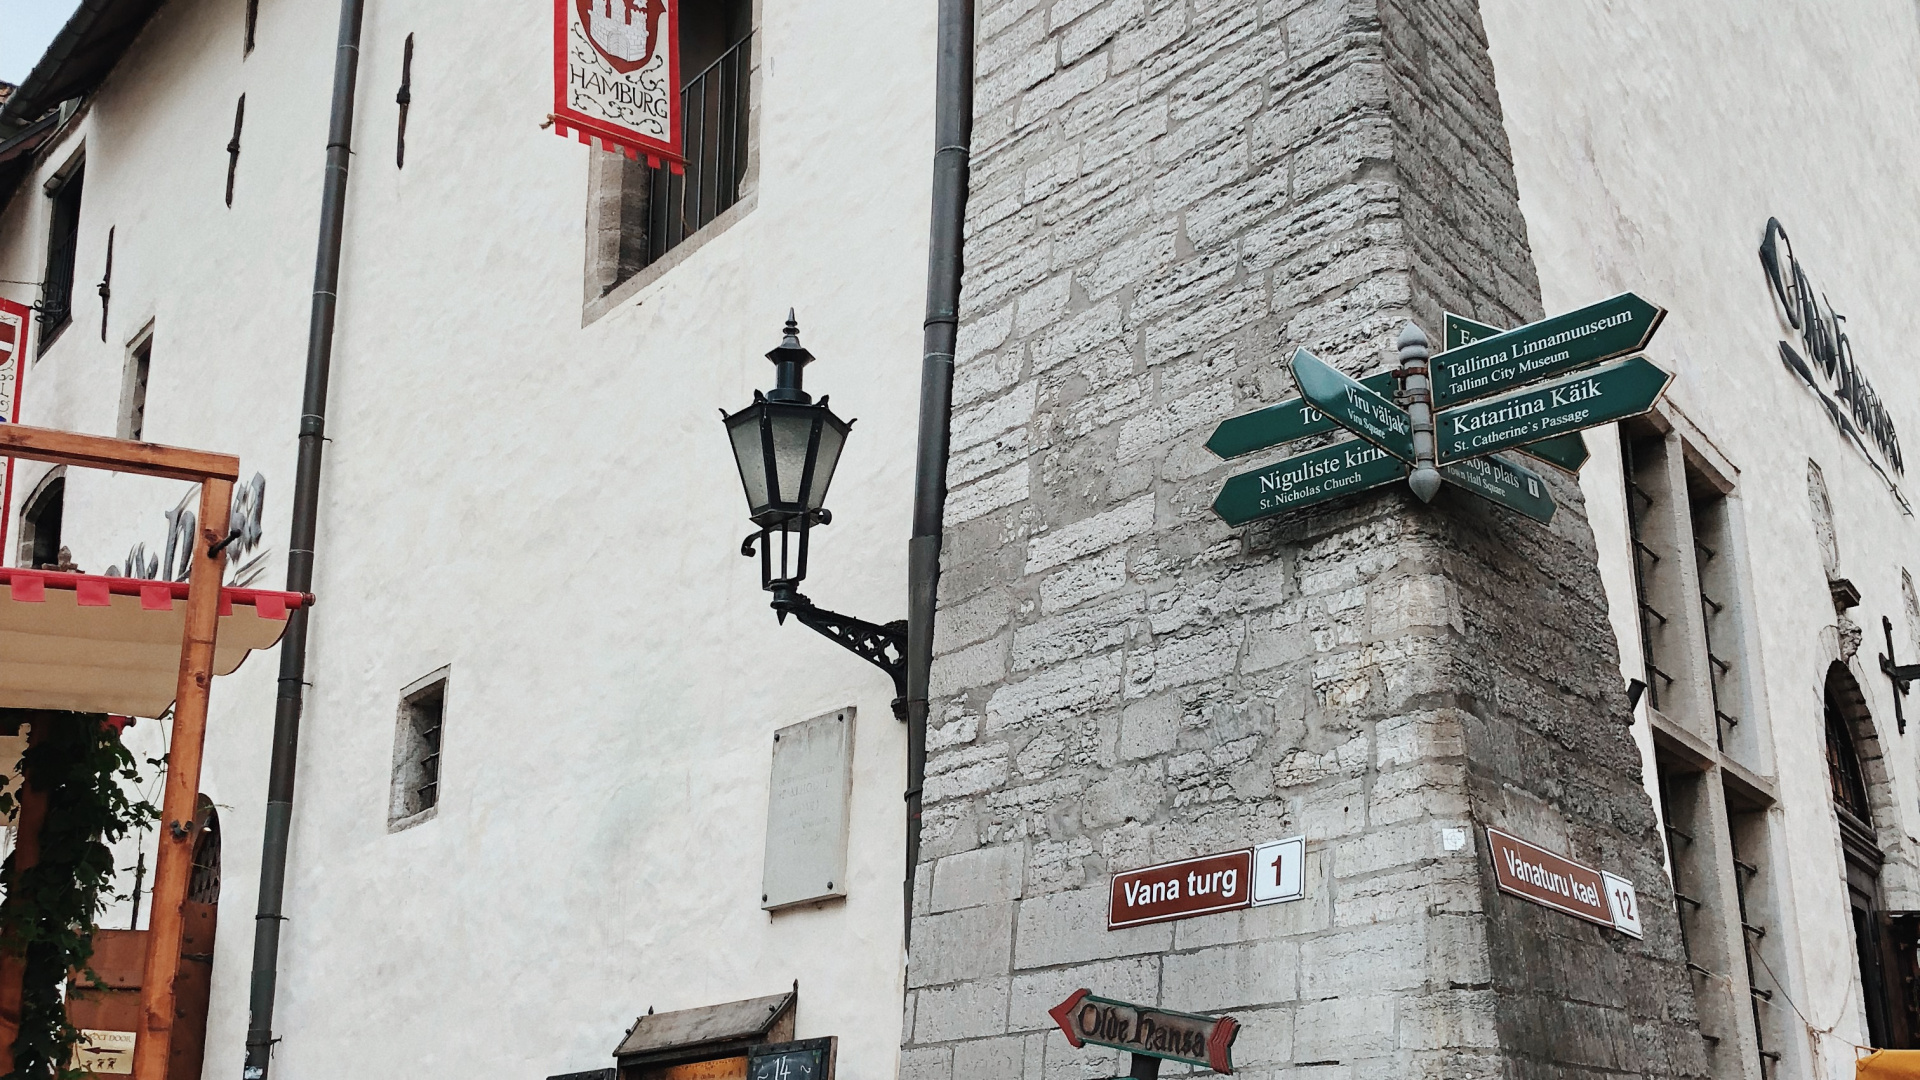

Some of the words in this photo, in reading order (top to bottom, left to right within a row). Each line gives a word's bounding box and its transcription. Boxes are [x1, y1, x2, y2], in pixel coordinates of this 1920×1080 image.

[570, 63, 668, 119] HAMBURG
[1447, 351, 1507, 379] Tallinna
[1511, 310, 1634, 359] Linnamuuseum
[1449, 375, 1489, 395] Tallinn
[1491, 366, 1516, 383] City
[1519, 350, 1570, 374] Museum
[1344, 384, 1370, 414] Viru
[1372, 404, 1406, 436] väljak
[1347, 408, 1363, 426] Viru
[1363, 417, 1386, 439] Square
[1452, 398, 1546, 436] Katariina
[1550, 378, 1603, 409] Käik
[1454, 439, 1469, 453] St.
[1541, 407, 1590, 429] Passage
[1259, 458, 1340, 494] Niguliste
[1344, 445, 1389, 469] kirik
[1259, 498, 1273, 510] St.
[1275, 485, 1321, 505] Nicholas
[1324, 472, 1362, 491] Church
[1466, 471, 1482, 487] Hall
[1482, 478, 1506, 497] Square
[1493, 464, 1520, 488] plats
[1123, 878, 1180, 908] Vana
[1187, 868, 1238, 897] turg
[1270, 855, 1283, 887] 1
[1502, 846, 1570, 897] Vanaturu
[1569, 873, 1601, 908] kael
[1615, 888, 1634, 921] 12
[1077, 1003, 1130, 1042] Olde
